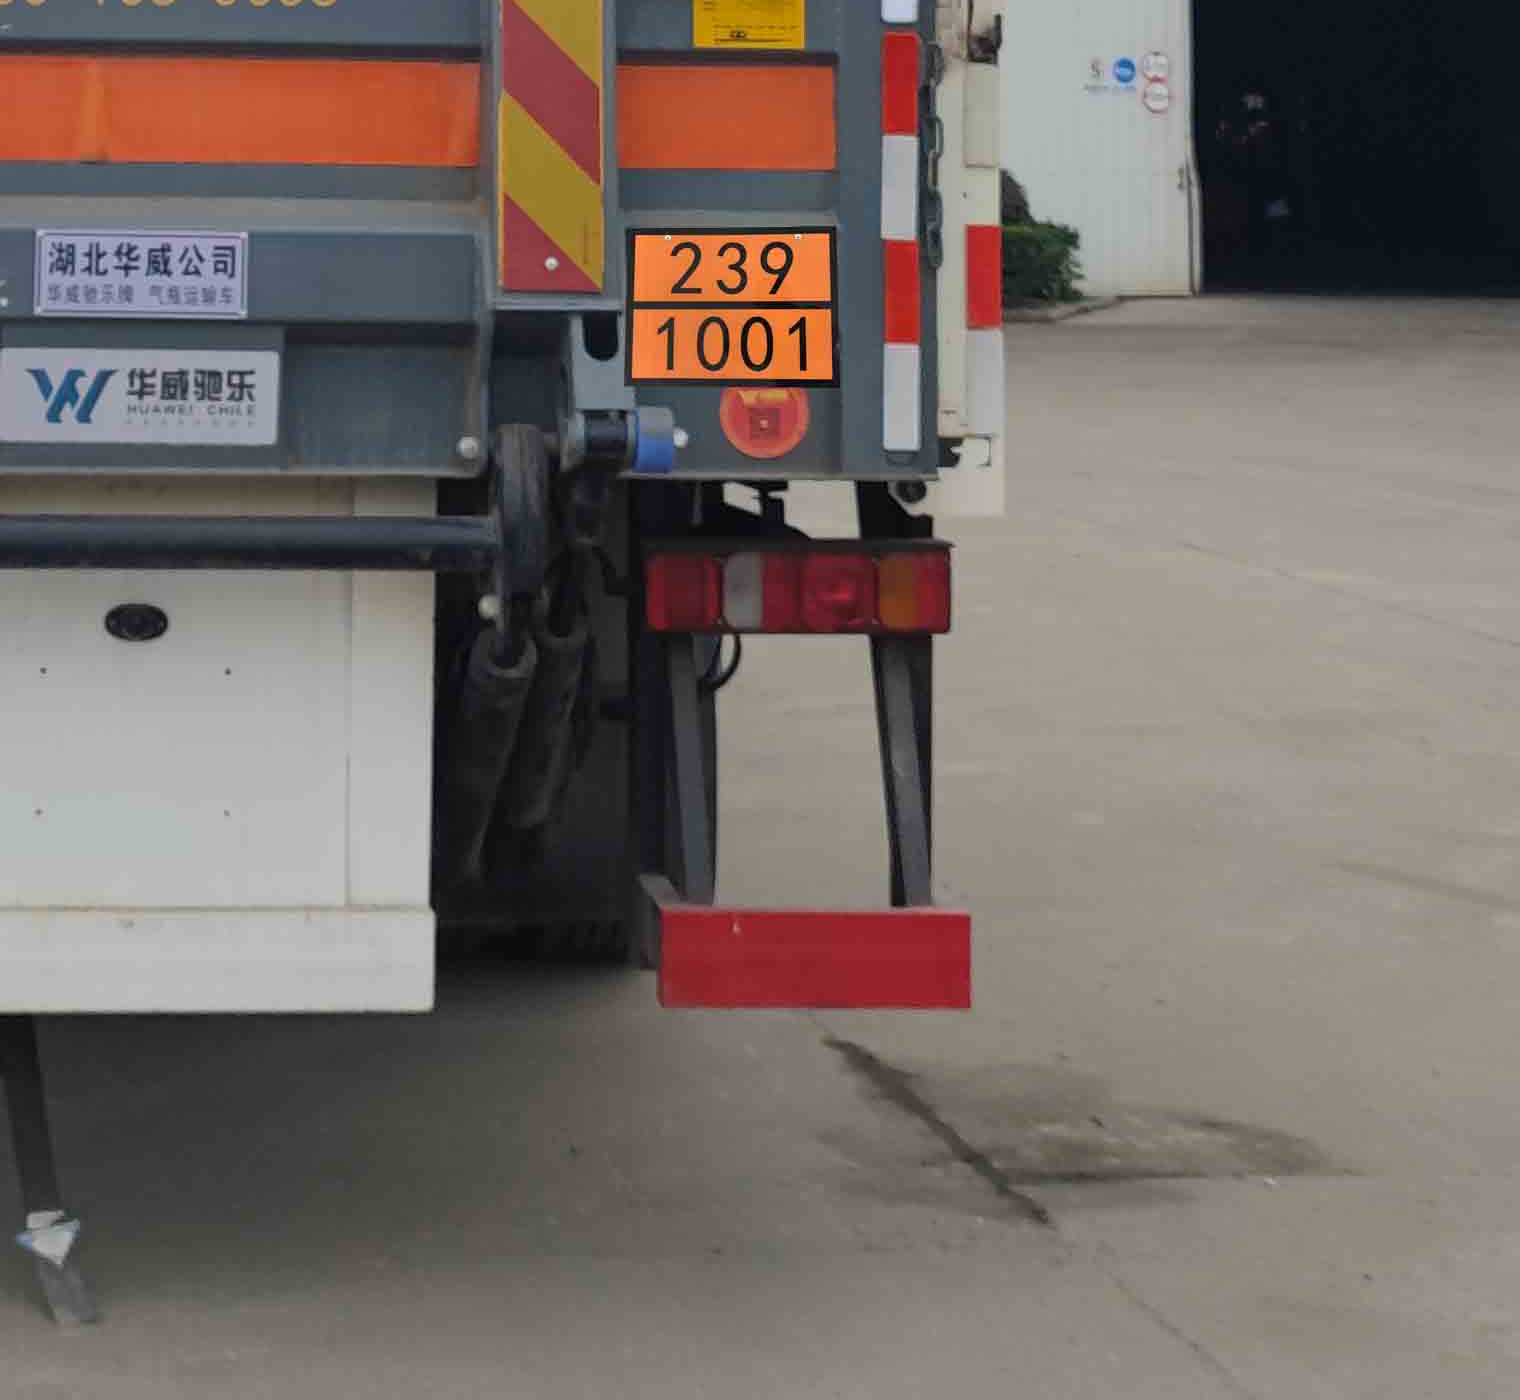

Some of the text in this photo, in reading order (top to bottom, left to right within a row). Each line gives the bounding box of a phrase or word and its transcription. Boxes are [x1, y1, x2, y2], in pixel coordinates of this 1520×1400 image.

[48, 242, 237, 279] 湖北华威公司
[669, 241, 794, 295] 239
[656, 316, 807, 372] 1001
[126, 368, 256, 402] 华威驰乐
[207, 404, 256, 416] CHILE
